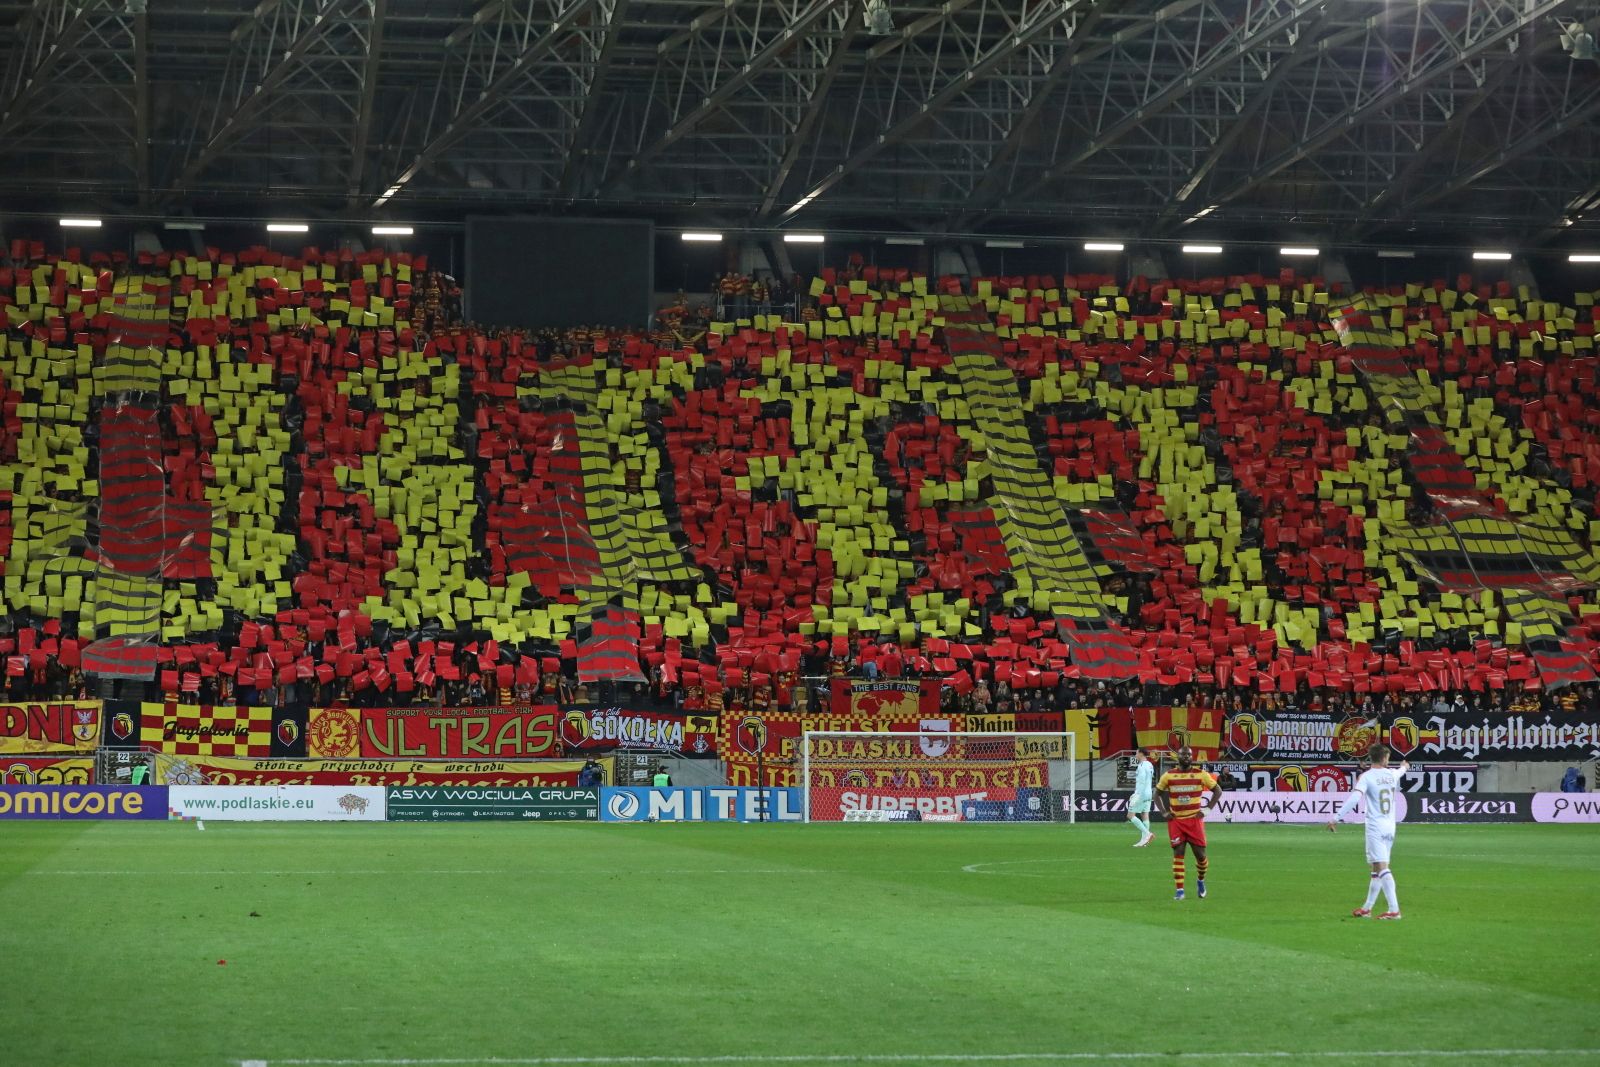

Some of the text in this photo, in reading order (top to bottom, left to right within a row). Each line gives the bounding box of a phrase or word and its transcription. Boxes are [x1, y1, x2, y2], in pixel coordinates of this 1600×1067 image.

[897, 684, 917, 692] FANS
[366, 714, 555, 756] ULTRAS
[591, 715, 682, 745] SOKÓŁKA
[801, 719, 892, 737] BIELSK
[1265, 720, 1337, 736] SPORTOWY
[781, 738, 912, 758] PODLASKI
[1267, 735, 1334, 751] BIAŁYSTOK
[119, 753, 128, 761] 22
[638, 756, 647, 764] 21
[539, 790, 597, 800] GRUPA
[839, 791, 988, 814] SUPERBET
[184, 796, 314, 812] www.podlaskie.eu
[650, 790, 801, 819] MITEL
[1421, 794, 1518, 814] kaizen
[522, 810, 541, 818] Jeep
[586, 809, 597, 817] FIAT
